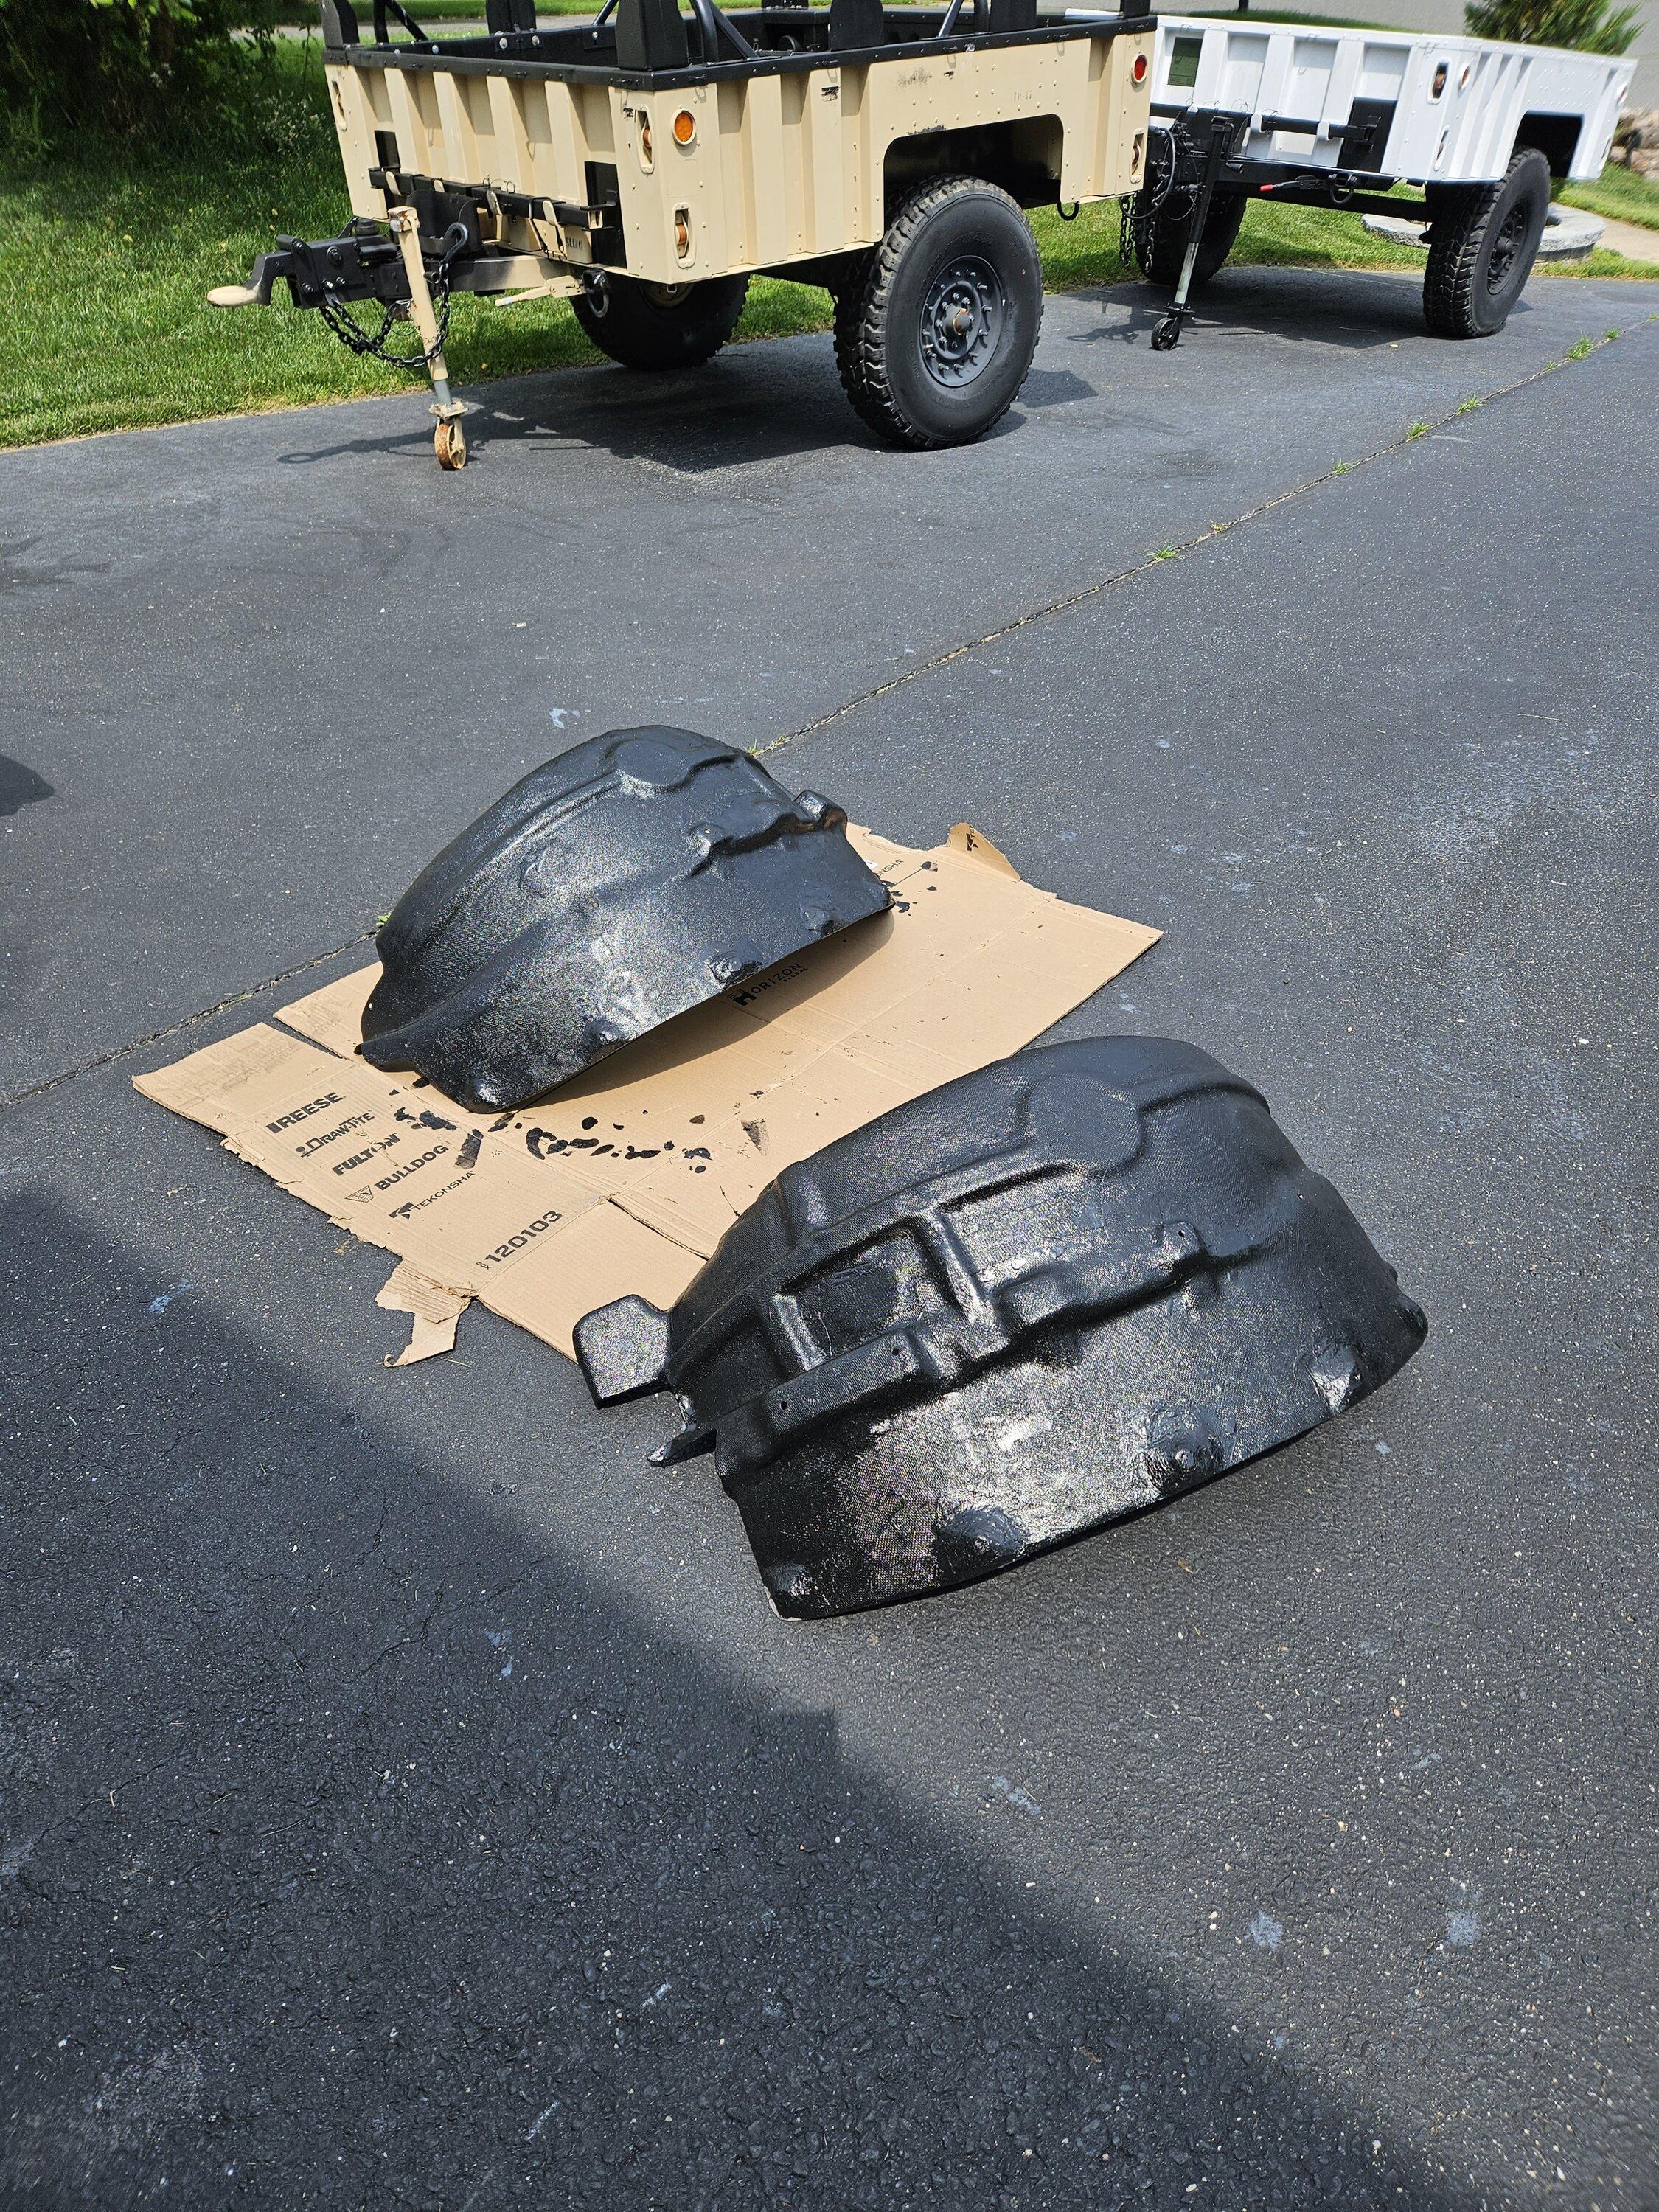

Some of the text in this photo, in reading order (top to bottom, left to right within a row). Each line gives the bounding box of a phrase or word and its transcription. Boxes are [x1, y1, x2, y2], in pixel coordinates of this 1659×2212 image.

[727, 963, 803, 1006] HORIZON
[276, 1092, 344, 1129] REESE
[332, 1133, 400, 1176] FULTON
[374, 1144, 449, 1190] BULLDOG
[411, 1172, 476, 1211] TEKONSHA
[484, 1211, 563, 1262] 120103
